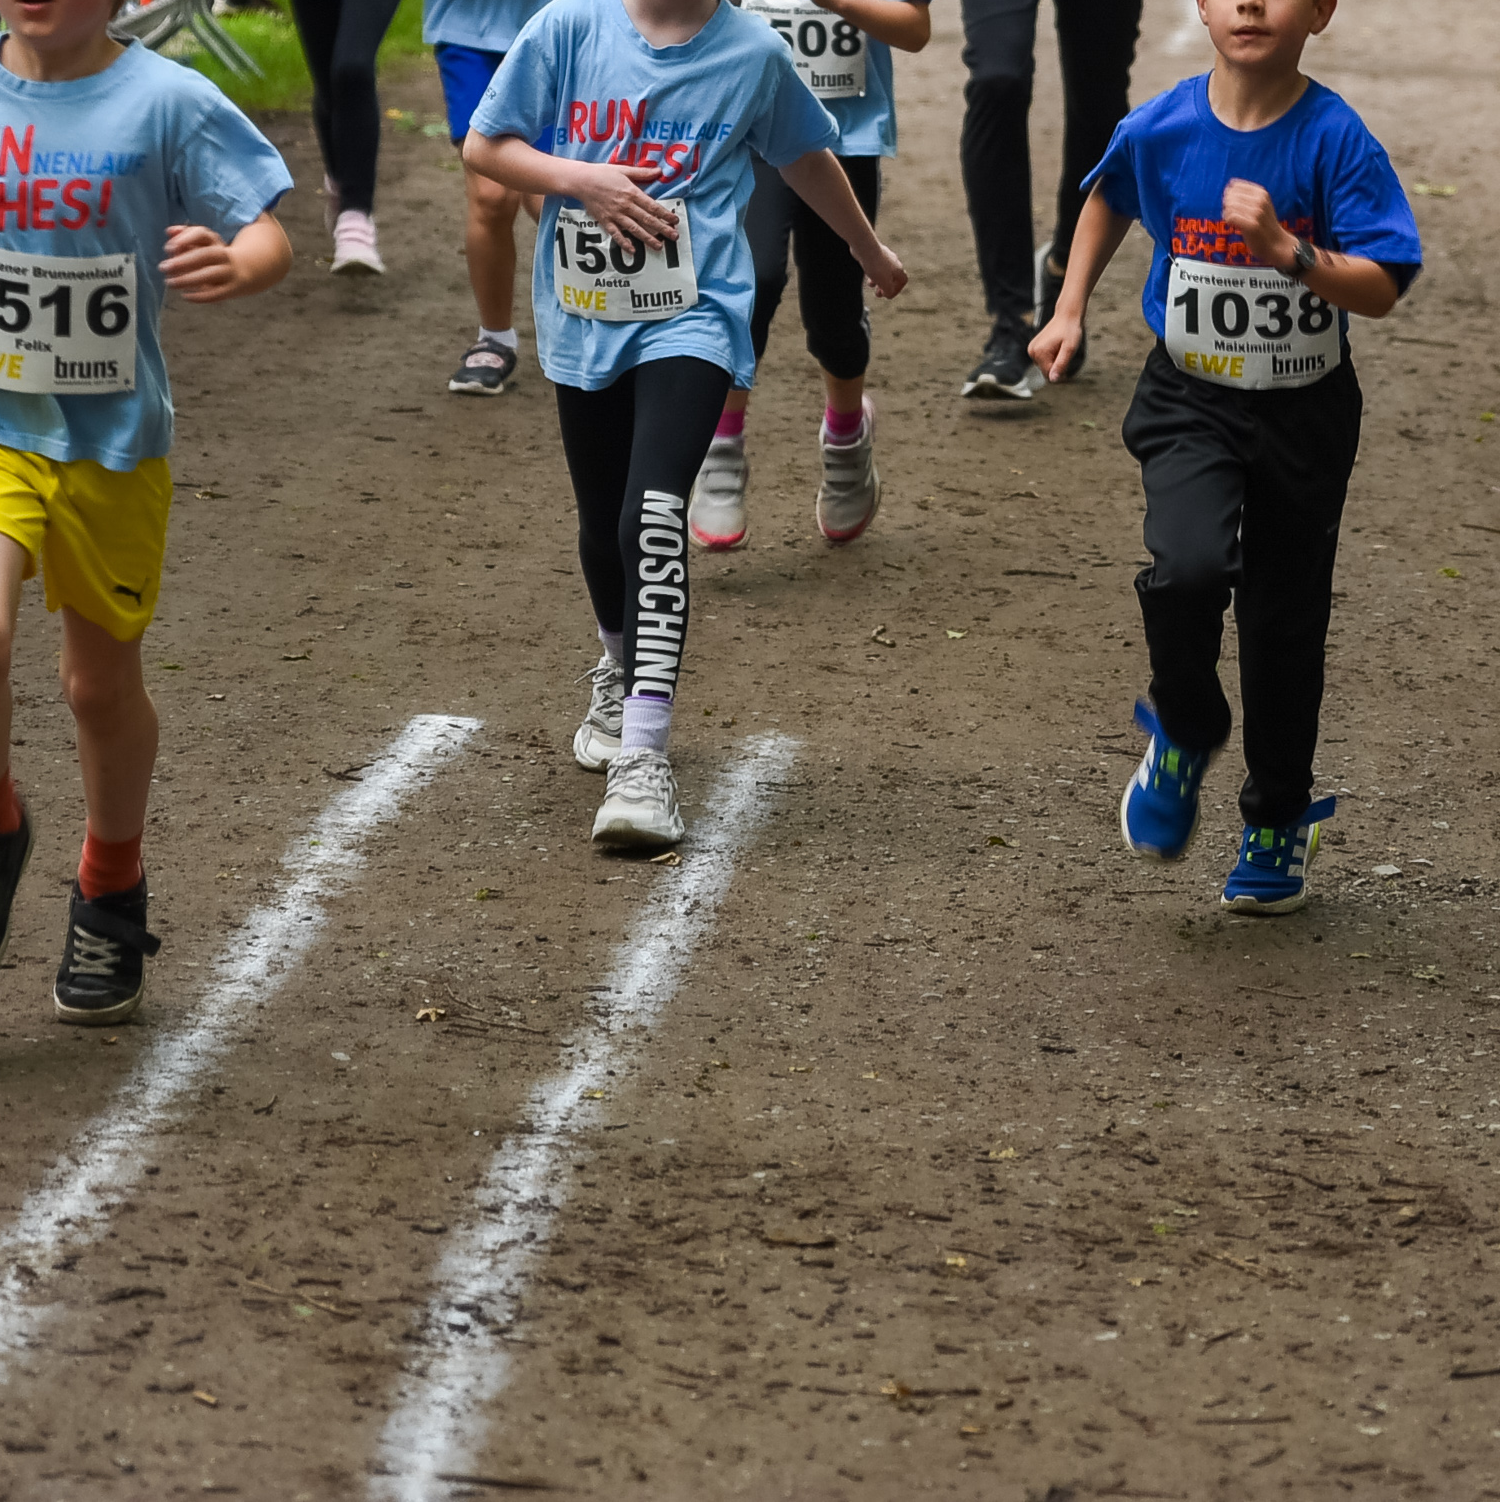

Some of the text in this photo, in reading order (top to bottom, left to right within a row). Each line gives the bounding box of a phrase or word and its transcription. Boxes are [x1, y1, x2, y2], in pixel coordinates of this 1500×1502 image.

[770, 18, 862, 59] 508
[810, 71, 855, 88] bruns
[555, 226, 680, 275] 1501
[32, 265, 125, 281] Brunnenlauf
[594, 278, 631, 288] Aletta
[1180, 269, 1246, 288] Everstener
[562, 285, 683, 312] EWE bruns
[1173, 287, 1334, 340] 1038
[14, 338, 53, 353] Felix
[53, 355, 119, 379] bruns
[1184, 352, 1245, 378] EWE
[1271, 353, 1326, 377] bruns
